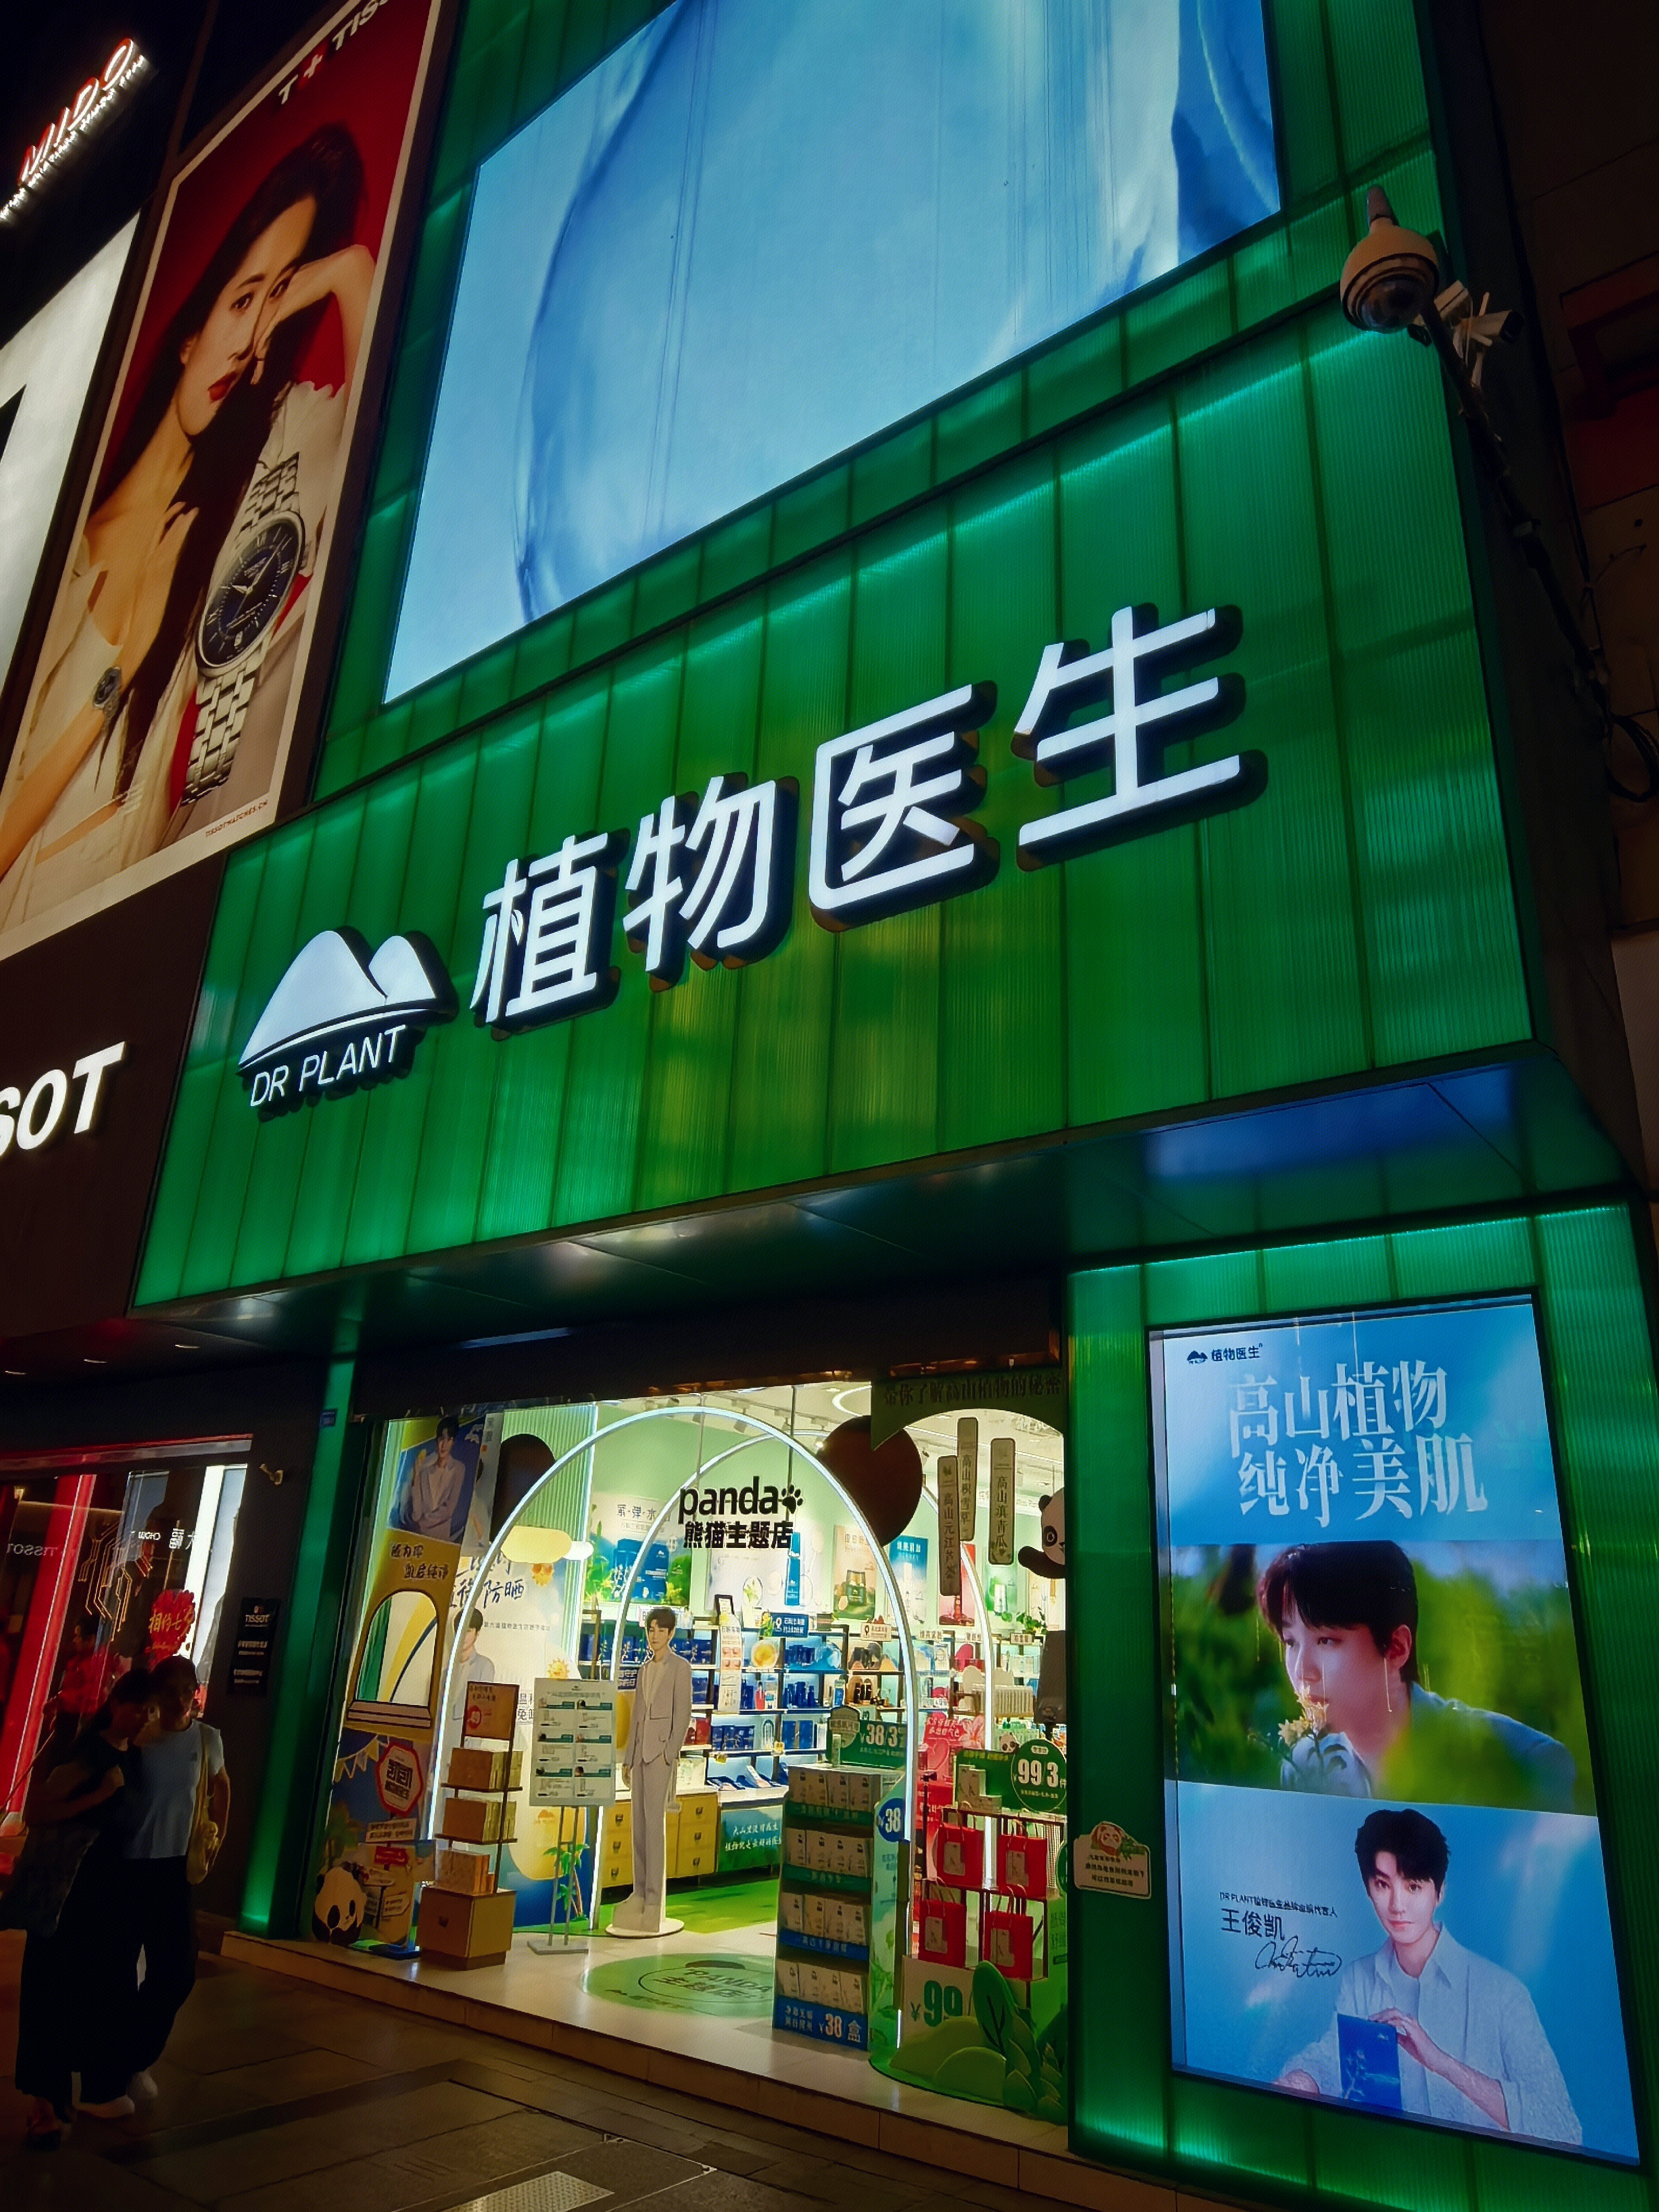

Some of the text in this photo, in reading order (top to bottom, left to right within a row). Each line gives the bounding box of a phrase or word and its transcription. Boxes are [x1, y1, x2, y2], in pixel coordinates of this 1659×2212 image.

[469, 605, 1241, 1024] 植物医生
[251, 1024, 408, 1107] DR PLANT
[1229, 1359, 1447, 1459] 高山植物
[678, 1476, 779, 1525] panda
[1238, 1432, 1488, 1528] 纯净美肌
[683, 1520, 793, 1549] 熊猫主题店
[1221, 1908, 1285, 1941] 王俊凯
